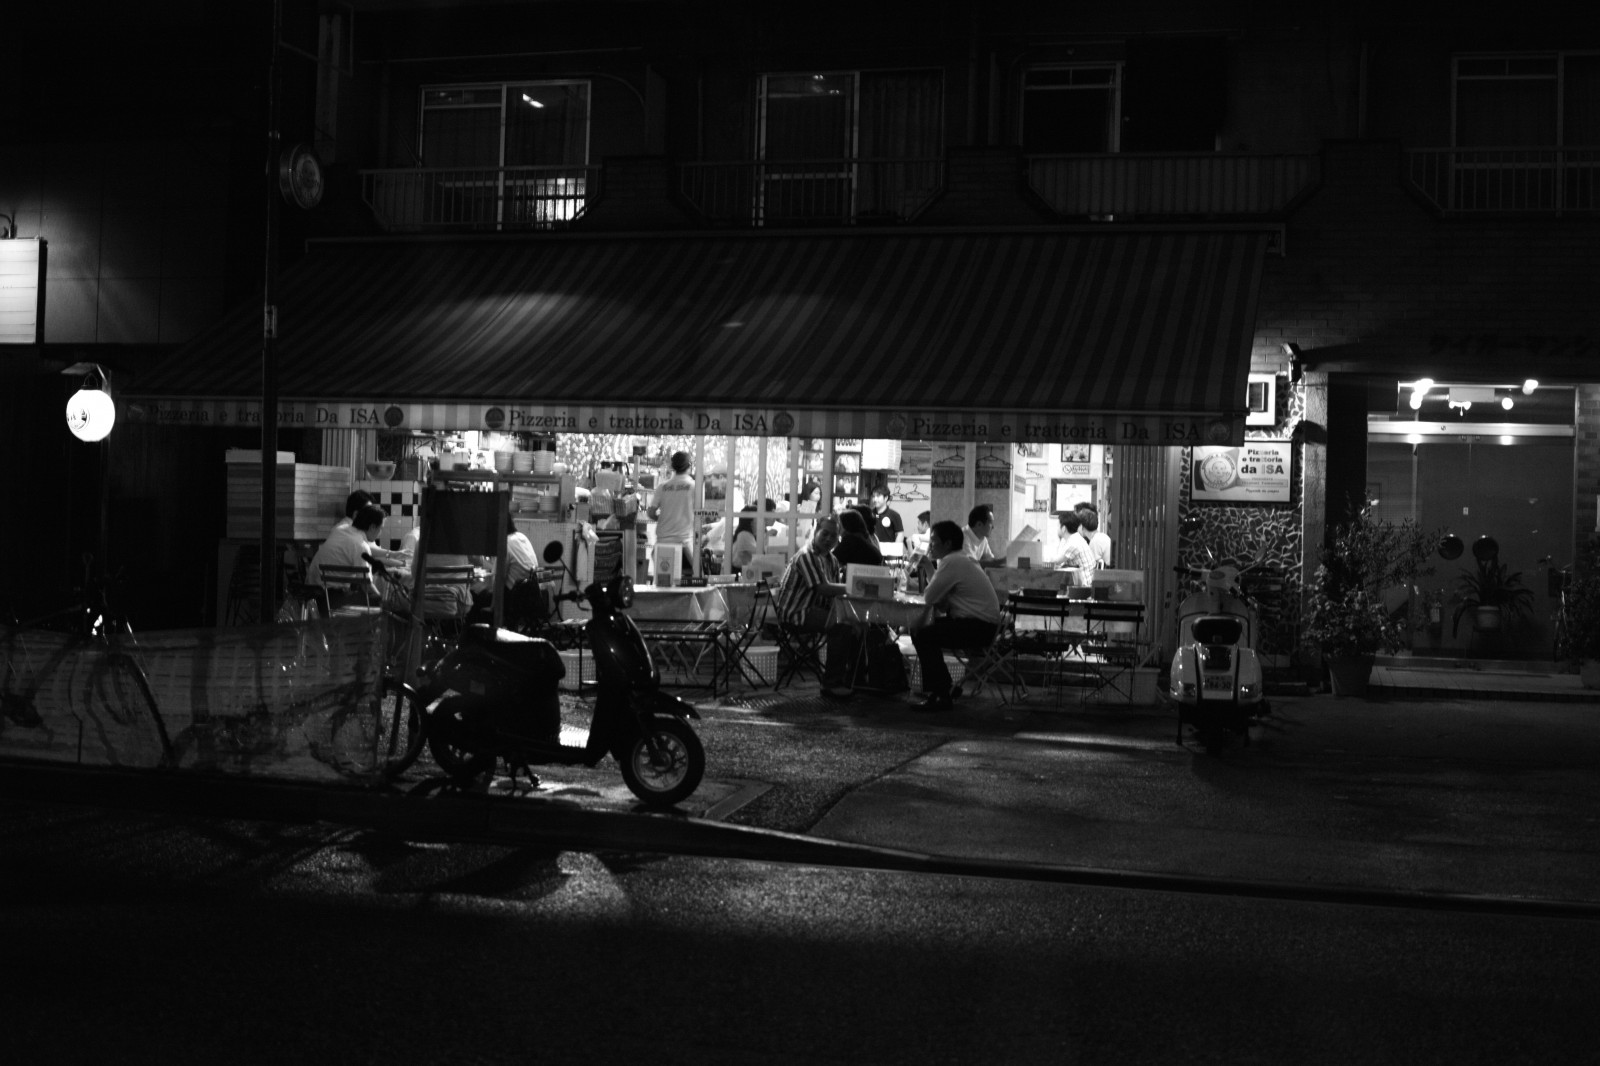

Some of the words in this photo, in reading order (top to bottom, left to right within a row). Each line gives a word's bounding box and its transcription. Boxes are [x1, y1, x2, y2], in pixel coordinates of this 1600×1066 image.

[218, 411, 228, 423] e
[316, 407, 338, 423] Da
[350, 408, 380, 425] ISA
[508, 410, 577, 428] Pizzeria
[588, 415, 598, 429] e
[609, 411, 684, 430] trattoria
[697, 412, 721, 431] Da
[734, 413, 768, 432] ISA
[912, 418, 988, 436] Pizzeria
[1001, 424, 1012, 437] e
[1024, 421, 1108, 439] trattoria
[1122, 422, 1149, 440] Da
[1164, 422, 1200, 441] ISA
[1241, 464, 1257, 474] da
[1261, 464, 1284, 475] ISA
